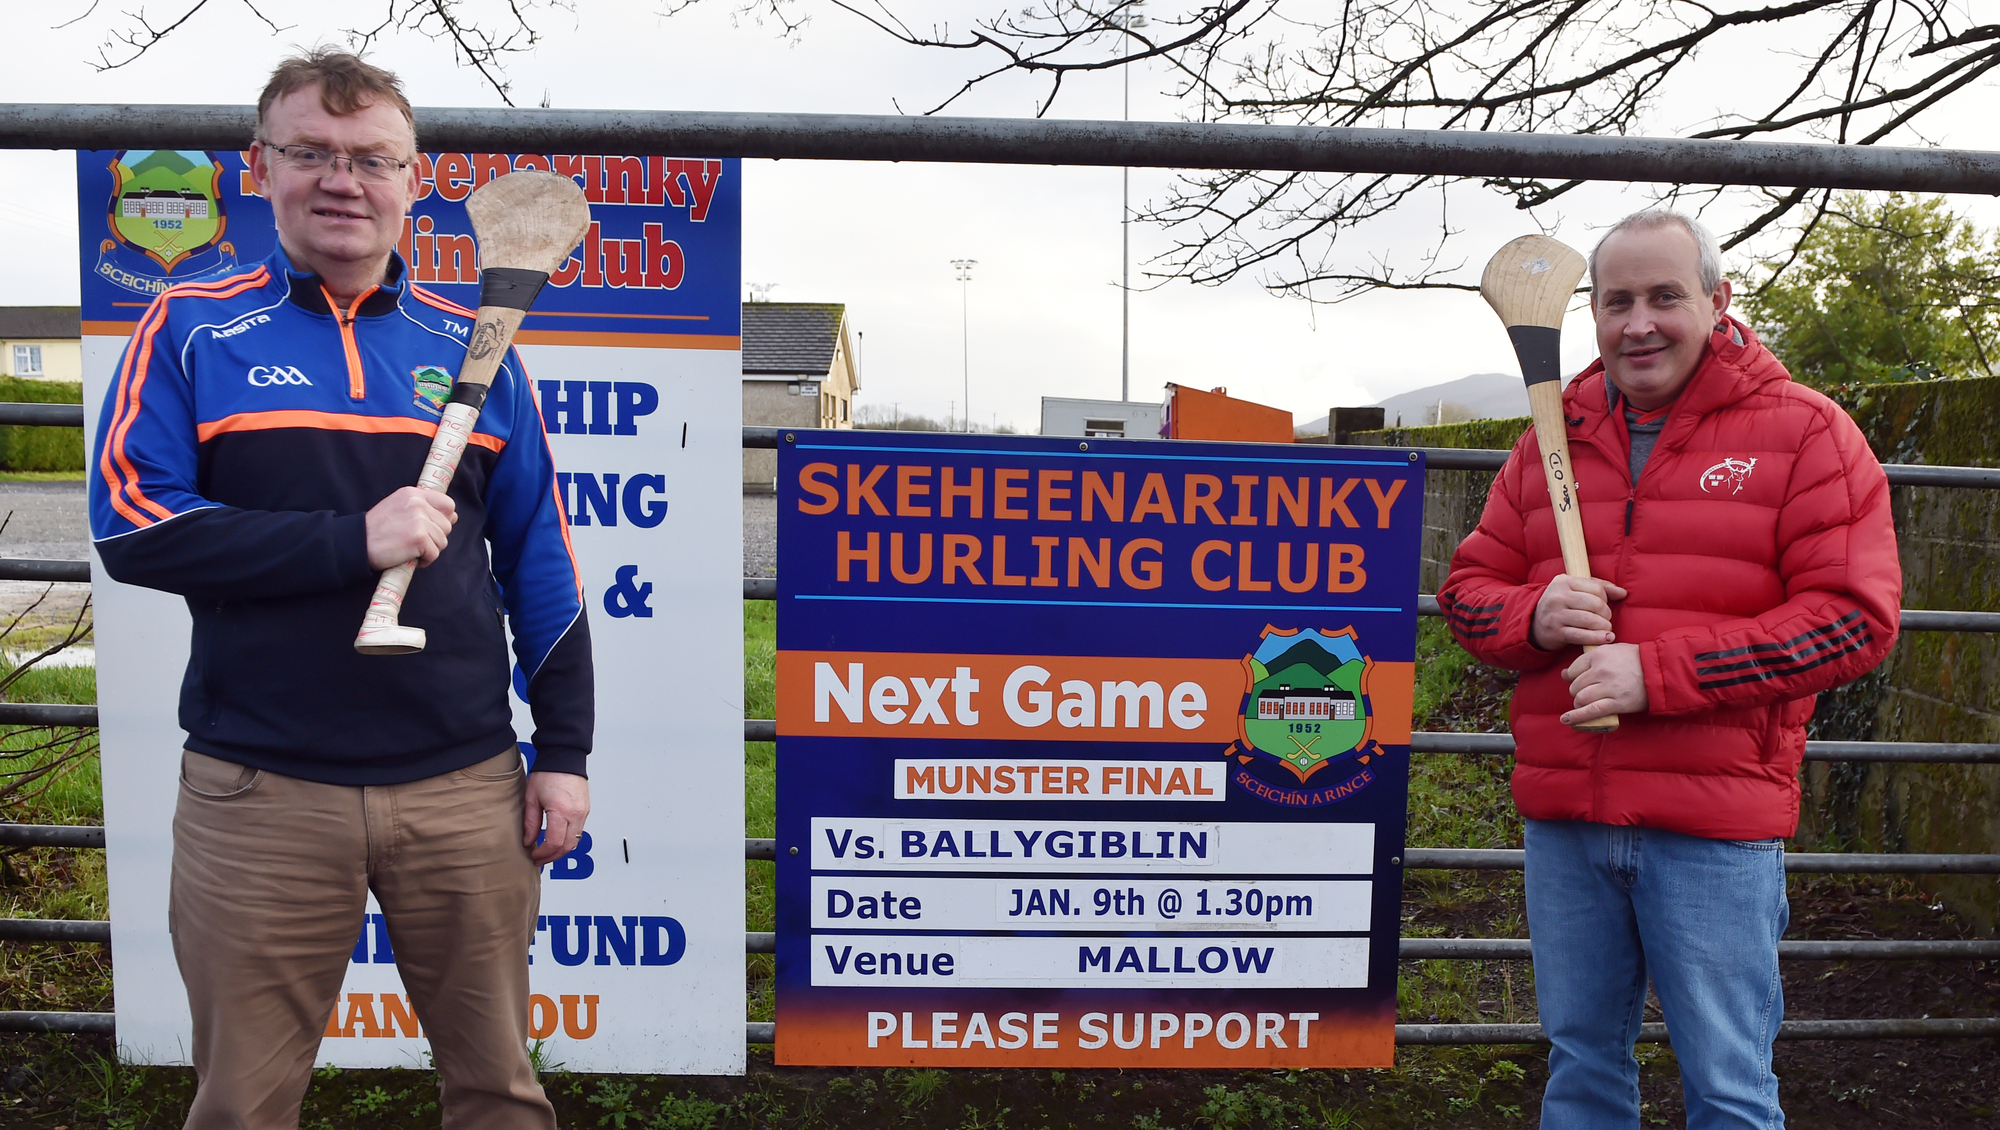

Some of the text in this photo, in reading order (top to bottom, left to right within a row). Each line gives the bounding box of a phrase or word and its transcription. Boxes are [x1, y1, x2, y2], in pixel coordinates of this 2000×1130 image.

[153, 219, 182, 230] 1952
[442, 318, 469, 337] TM
[247, 366, 314, 387] GAA
[798, 462, 1407, 529] SKEHEENARINKY
[836, 530, 1367, 593] HURLING CLUB
[814, 661, 1208, 730] Next Game
[1288, 723, 1321, 734] 1952
[906, 765, 1214, 796] MUNSTER FINAL
[1236, 770, 1372, 806] SCEICHÍN A RINCE
[824, 828, 1208, 860] Vs. BALLYGIBLIN
[827, 887, 1313, 923] Date JAN. 9th @ 1.30pm
[824, 945, 1275, 976] Venue MALLOW
[528, 993, 600, 1040] OU
[867, 1011, 1320, 1050] PLEASE SUPPORT
